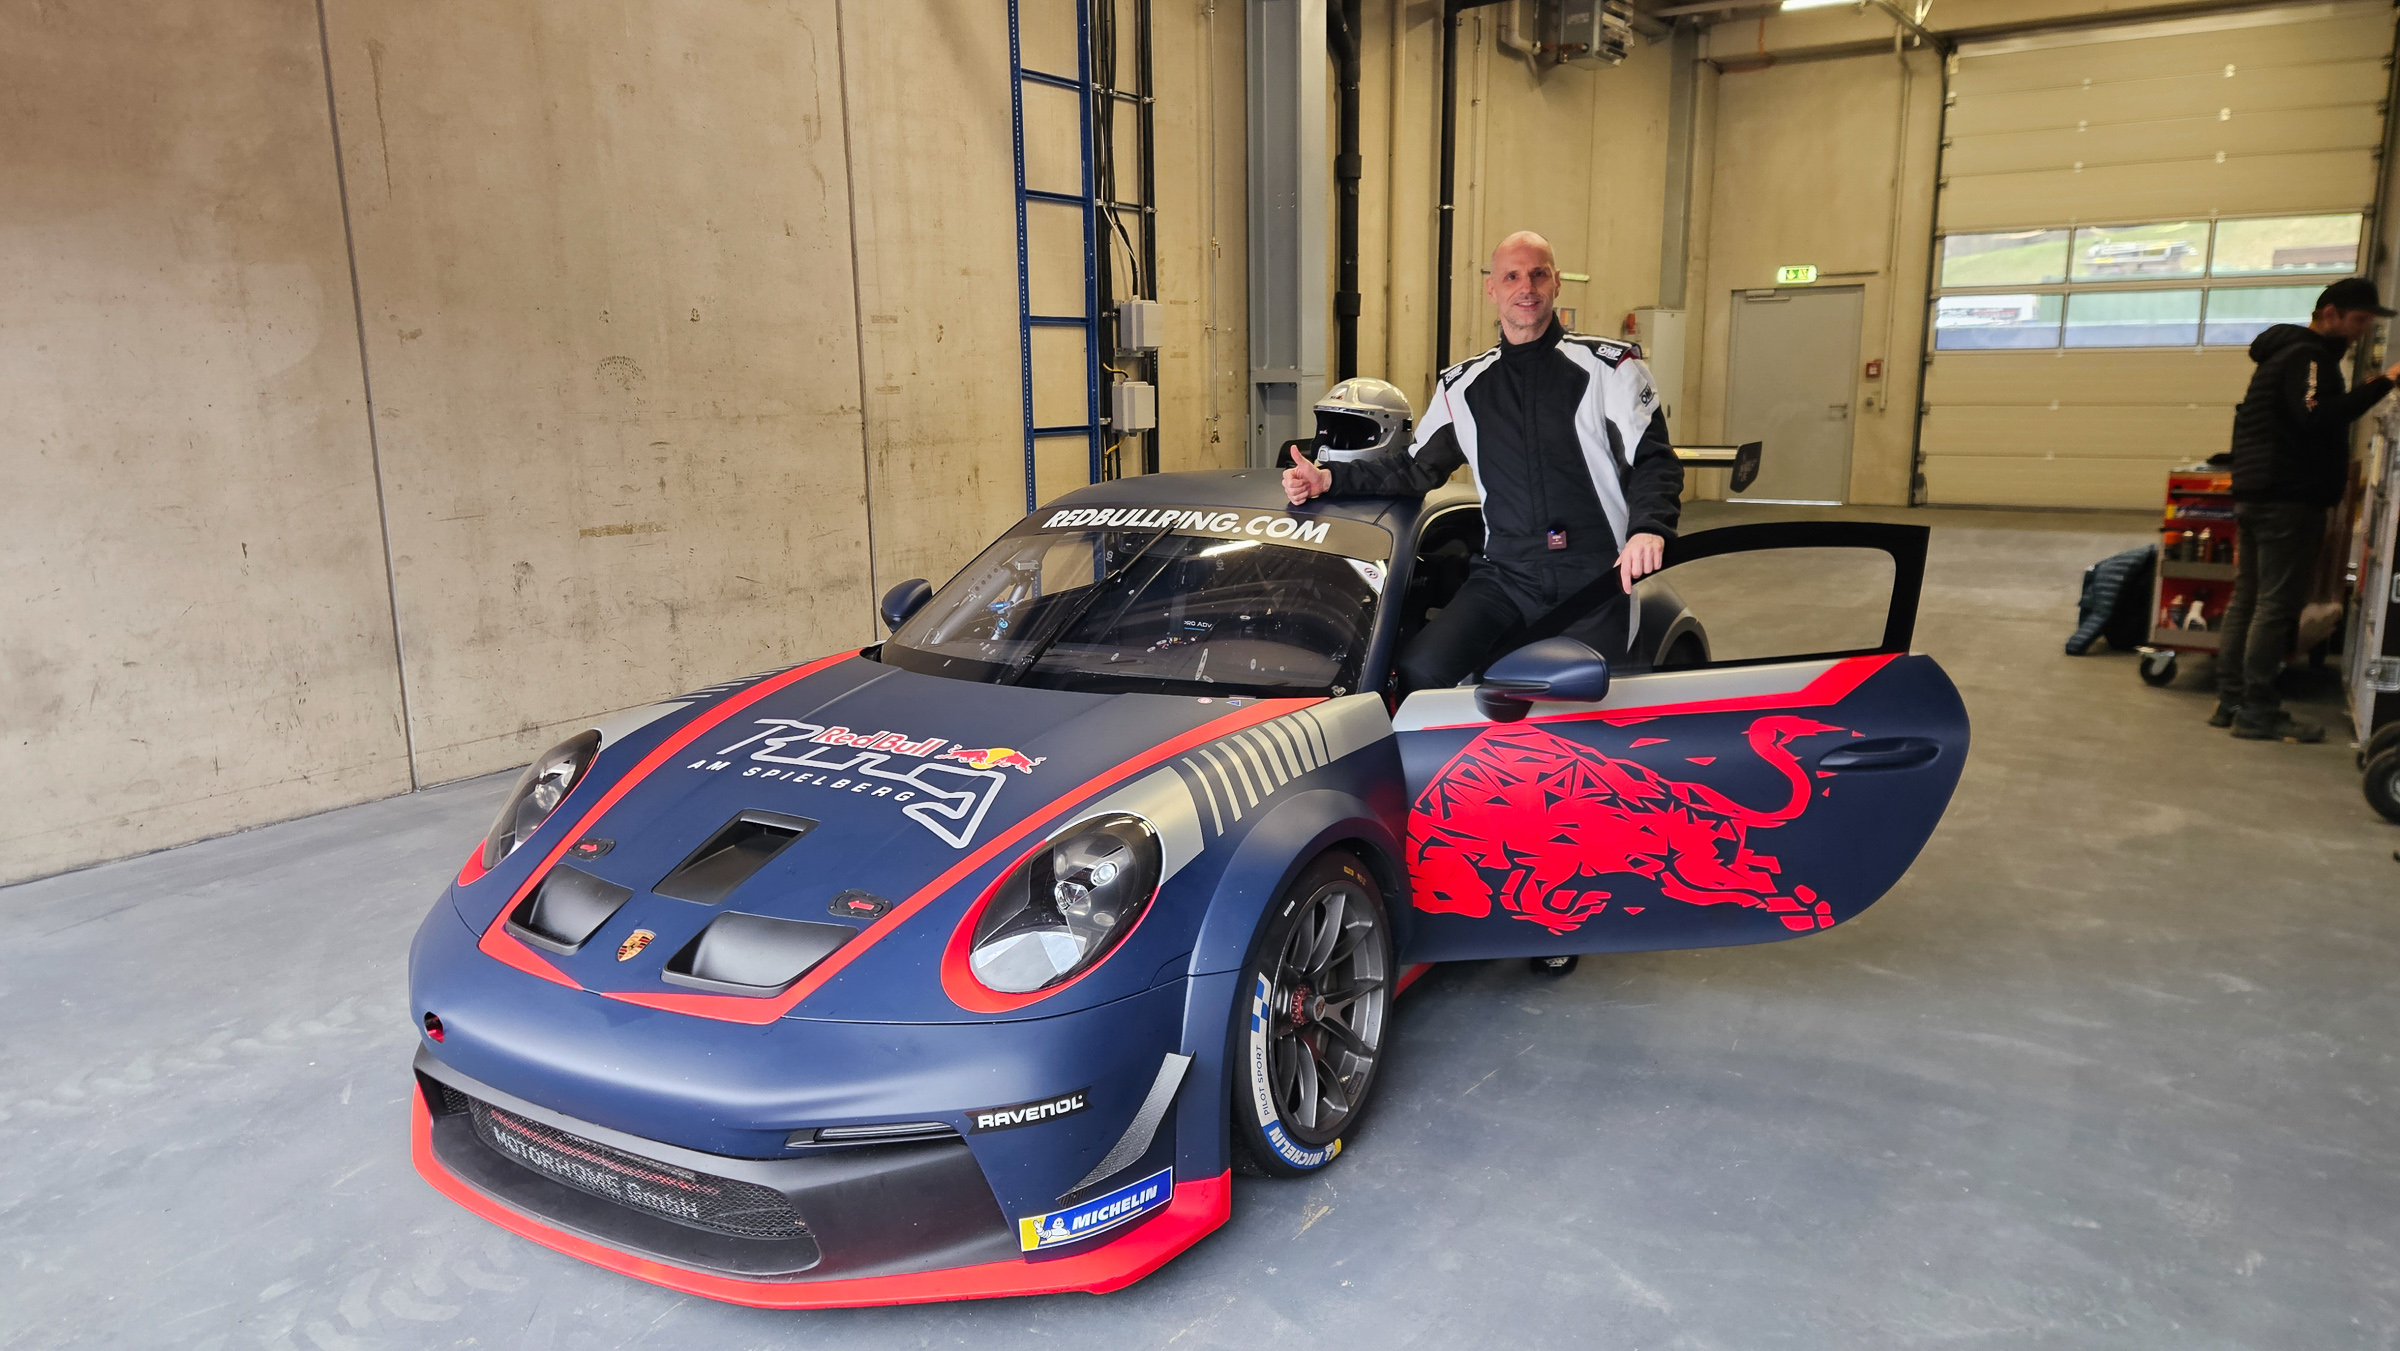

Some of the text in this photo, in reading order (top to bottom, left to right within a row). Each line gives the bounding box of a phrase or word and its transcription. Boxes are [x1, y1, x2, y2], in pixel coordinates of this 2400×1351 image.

[1597, 345, 1622, 358] OMP
[1042, 508, 1331, 544] REDBULLRING.COM
[687, 759, 916, 802] AM SPIELBERG
[1256, 1044, 1270, 1116] PILOT SPORT
[977, 1095, 1084, 1129] RAVENOL
[493, 1126, 621, 1201] MOTORHOME
[1268, 1126, 1324, 1166] MICHELIN
[1071, 1184, 1159, 1231] MICHELIN
